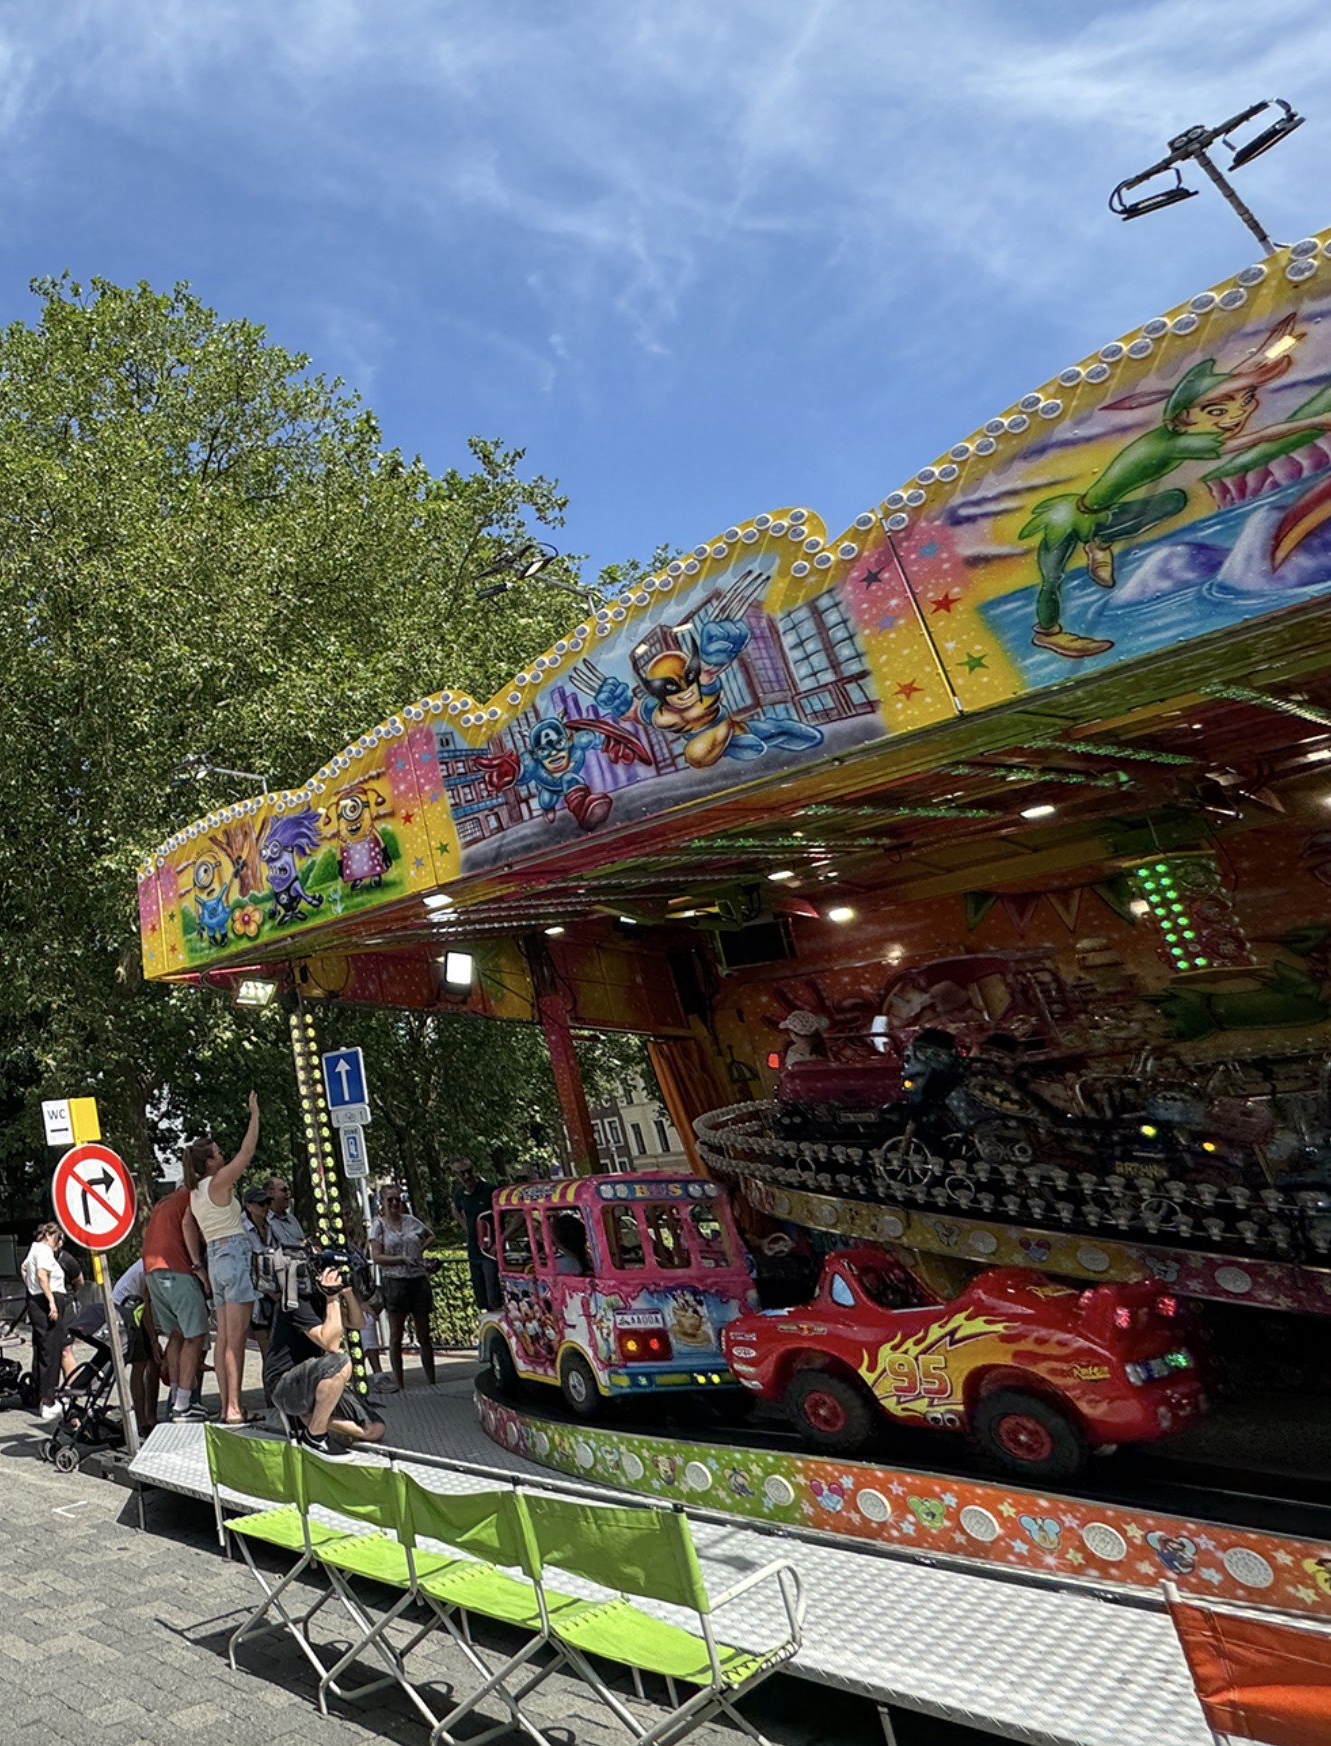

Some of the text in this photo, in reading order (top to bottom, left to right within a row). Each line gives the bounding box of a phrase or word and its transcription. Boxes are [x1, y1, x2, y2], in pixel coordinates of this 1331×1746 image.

[47, 1108, 67, 1120] WC
[633, 1183, 683, 1198] BUS
[886, 1354, 951, 1398] 95
